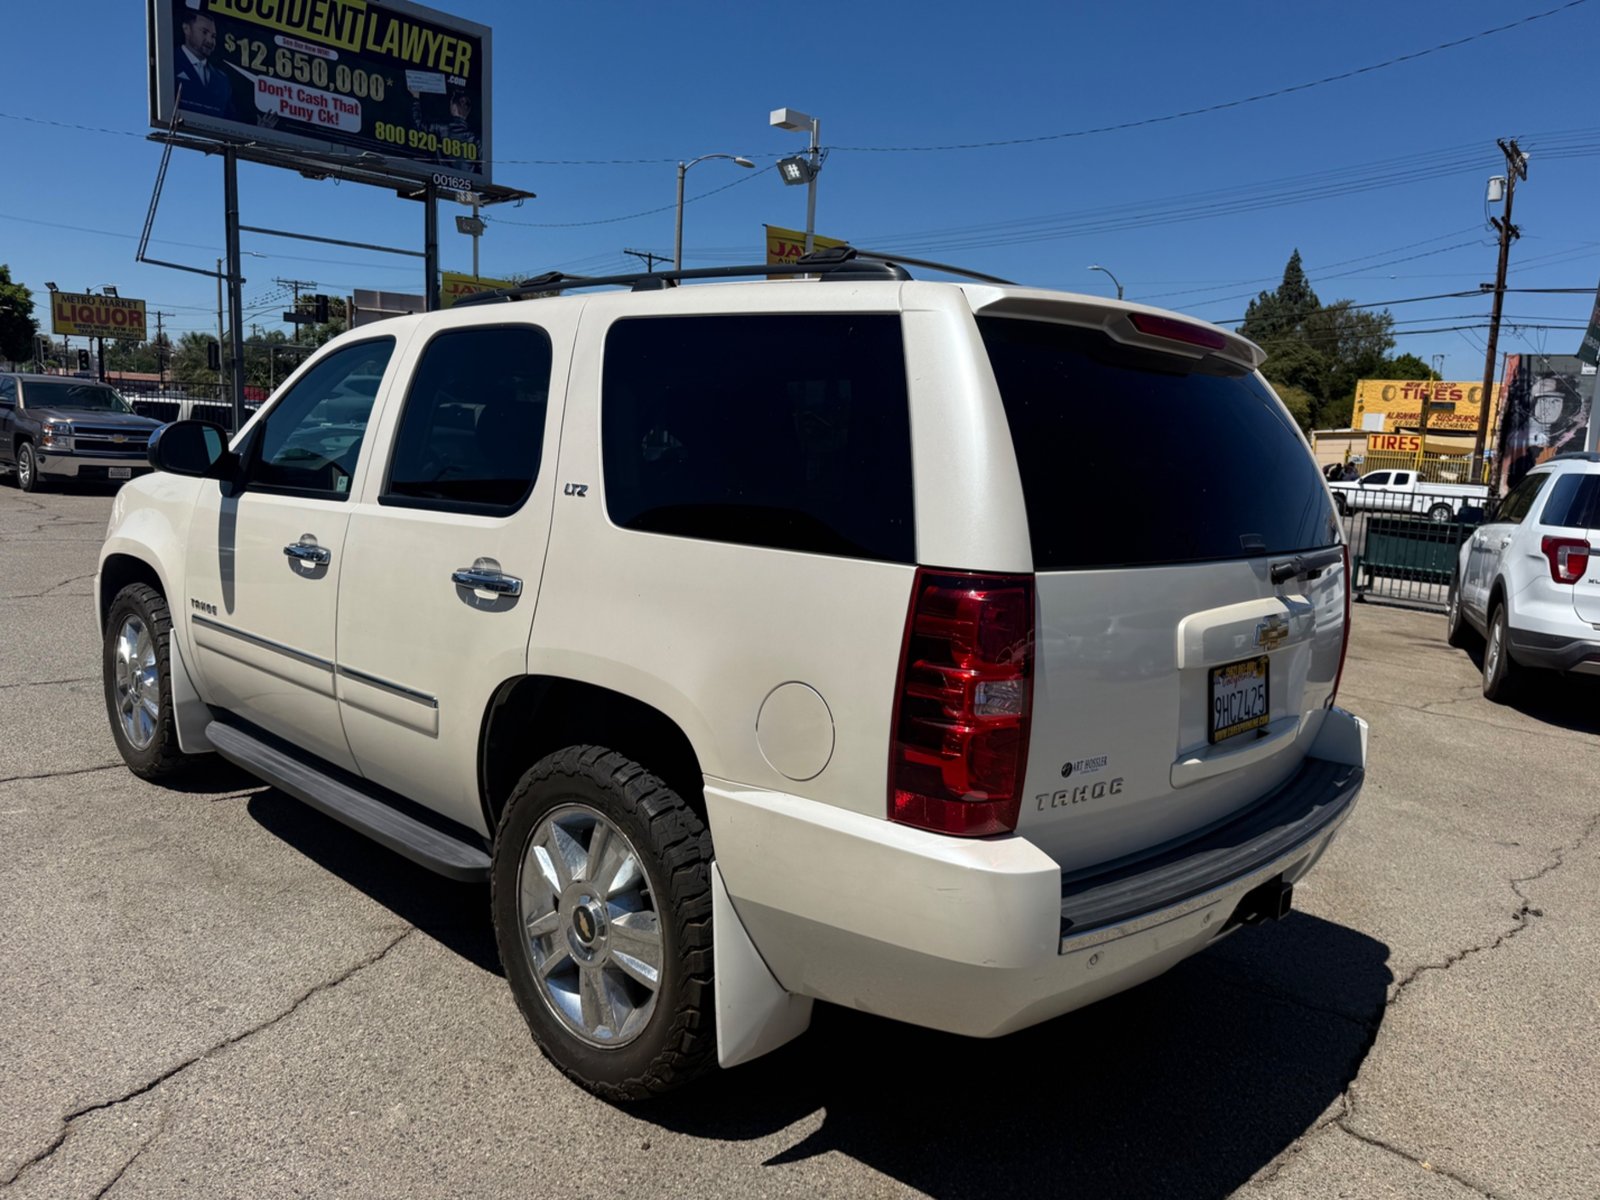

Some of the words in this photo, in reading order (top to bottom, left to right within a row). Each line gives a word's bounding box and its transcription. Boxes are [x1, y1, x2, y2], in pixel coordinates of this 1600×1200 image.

[210, 0, 364, 49] CIDENT
[366, 12, 473, 78] LAWYER
[447, 75, 467, 87] .com
[257, 79, 292, 98] Don't
[297, 89, 328, 106] Cash
[331, 97, 360, 116] That
[280, 101, 313, 124] Puny
[318, 108, 340, 126] Ck!
[375, 121, 405, 145] 800
[409, 131, 477, 160] 920-0810
[432, 173, 473, 190] 001625
[61, 295, 96, 306] METRO
[98, 298, 138, 309] MARKET
[57, 303, 143, 327] LIQUOR
[1371, 434, 1421, 451] TIRES
[564, 482, 589, 497] LTZ
[190, 598, 217, 616] TAHOE
[1215, 684, 1265, 730] 9HCZ425
[1035, 777, 1124, 812] TAHOE
